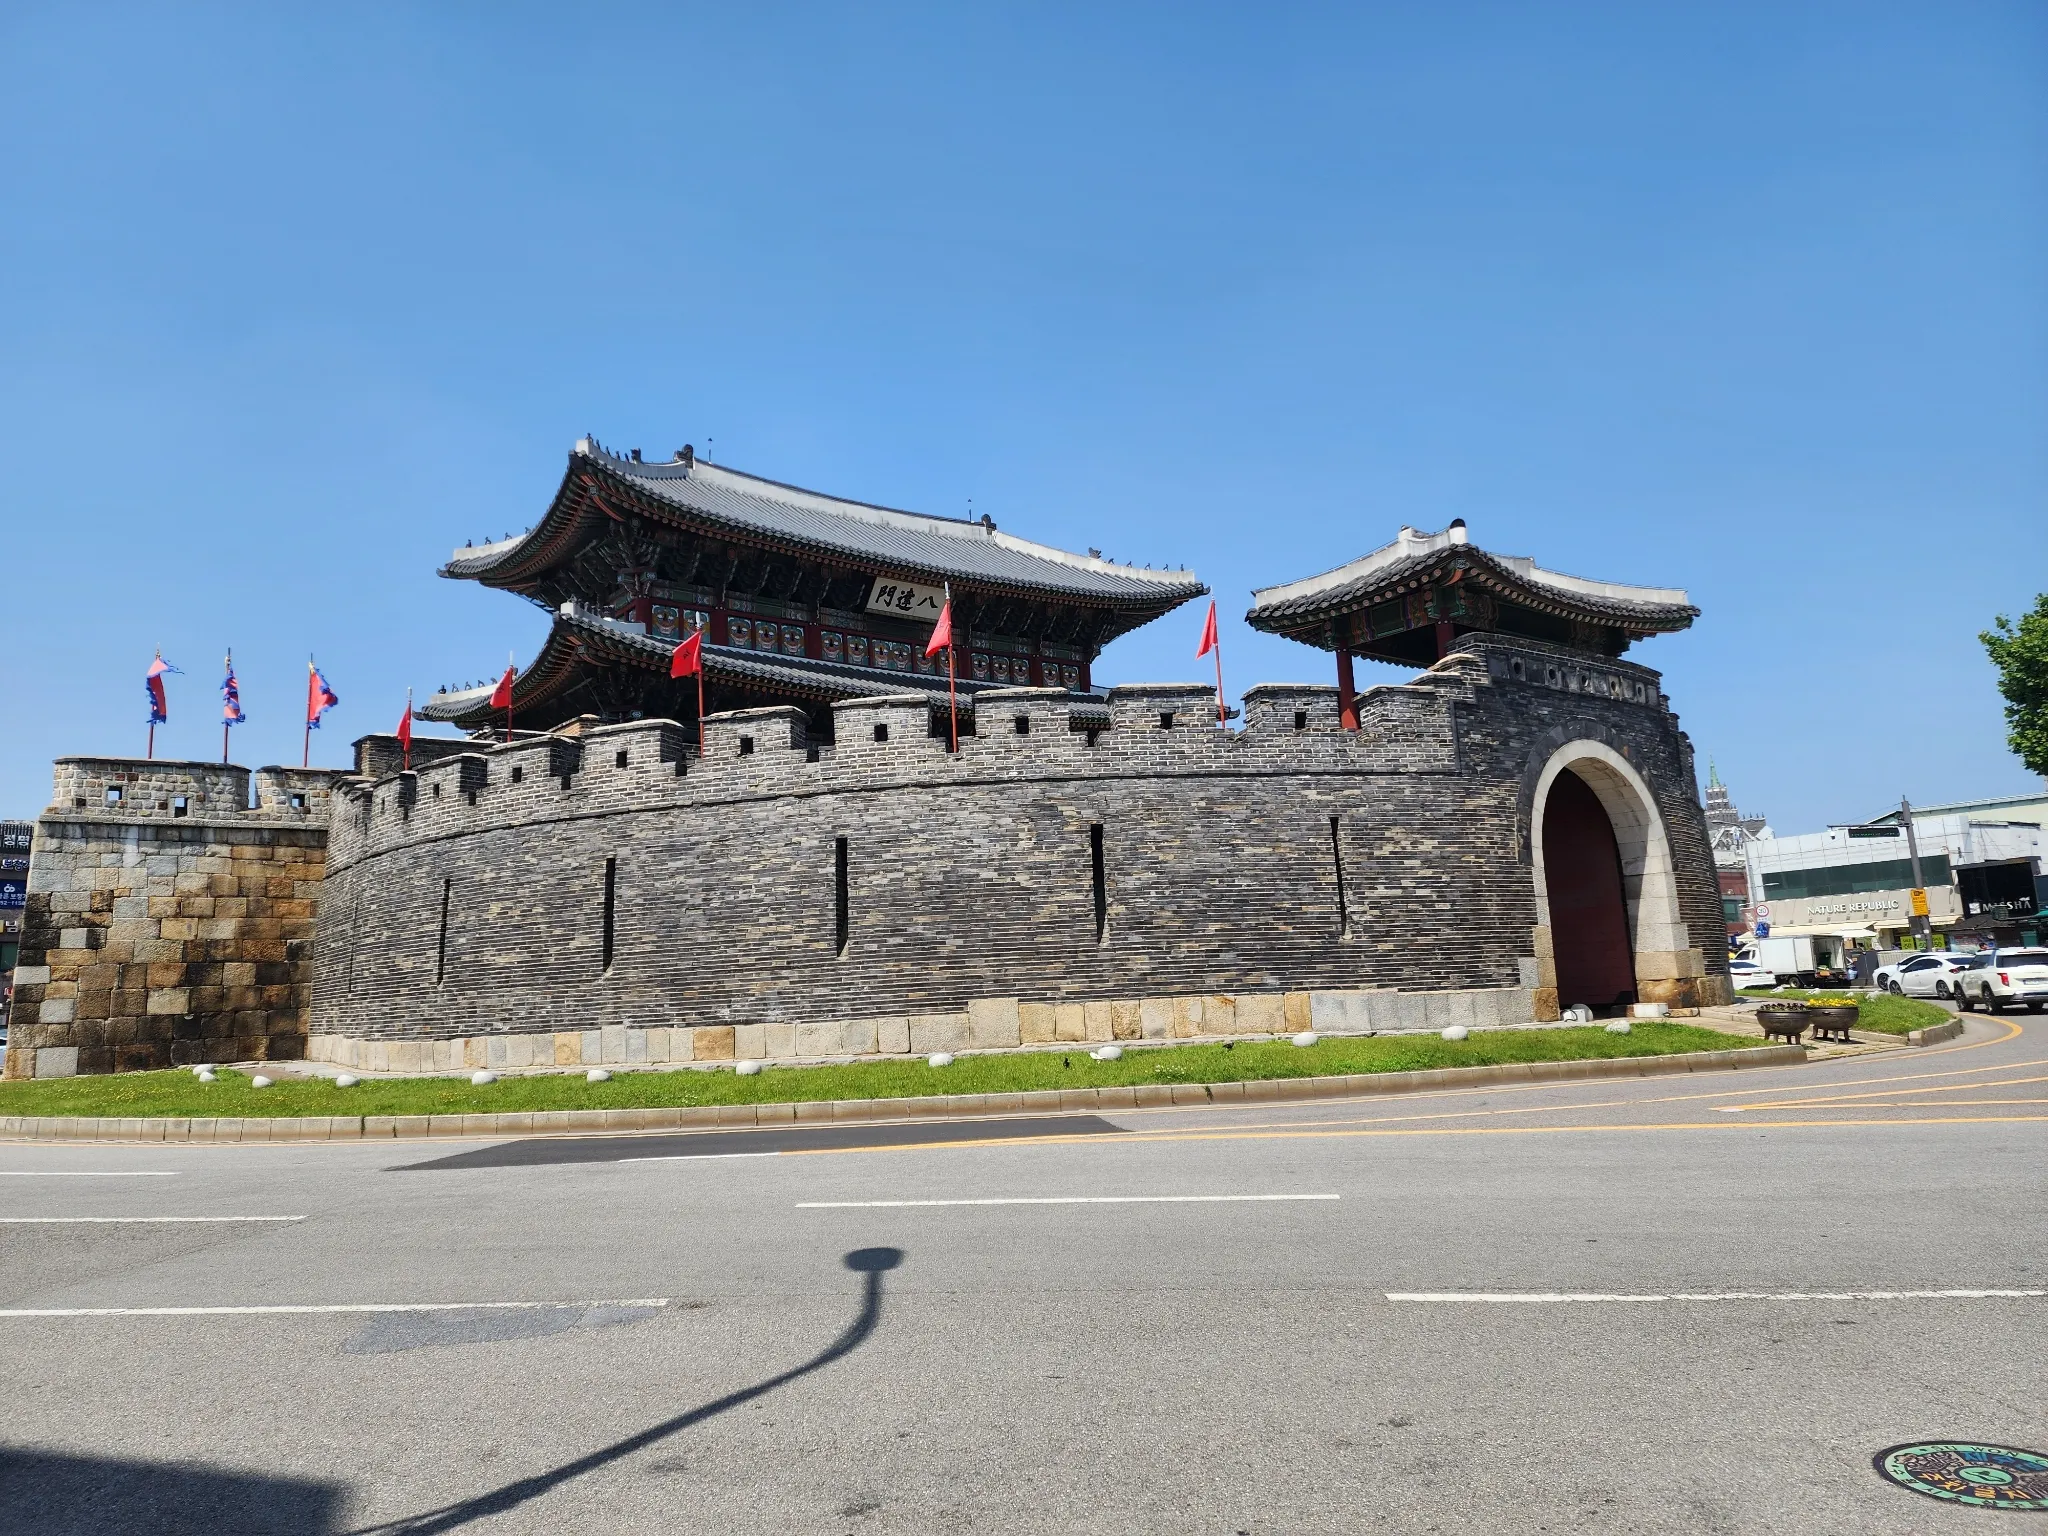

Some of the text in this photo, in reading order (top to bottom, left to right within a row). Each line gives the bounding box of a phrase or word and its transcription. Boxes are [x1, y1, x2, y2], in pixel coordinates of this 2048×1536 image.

[1807, 903, 1846, 915] NATURE
[1849, 899, 1899, 912] REPUBLIC
[1970, 1446, 2019, 1457] WON
